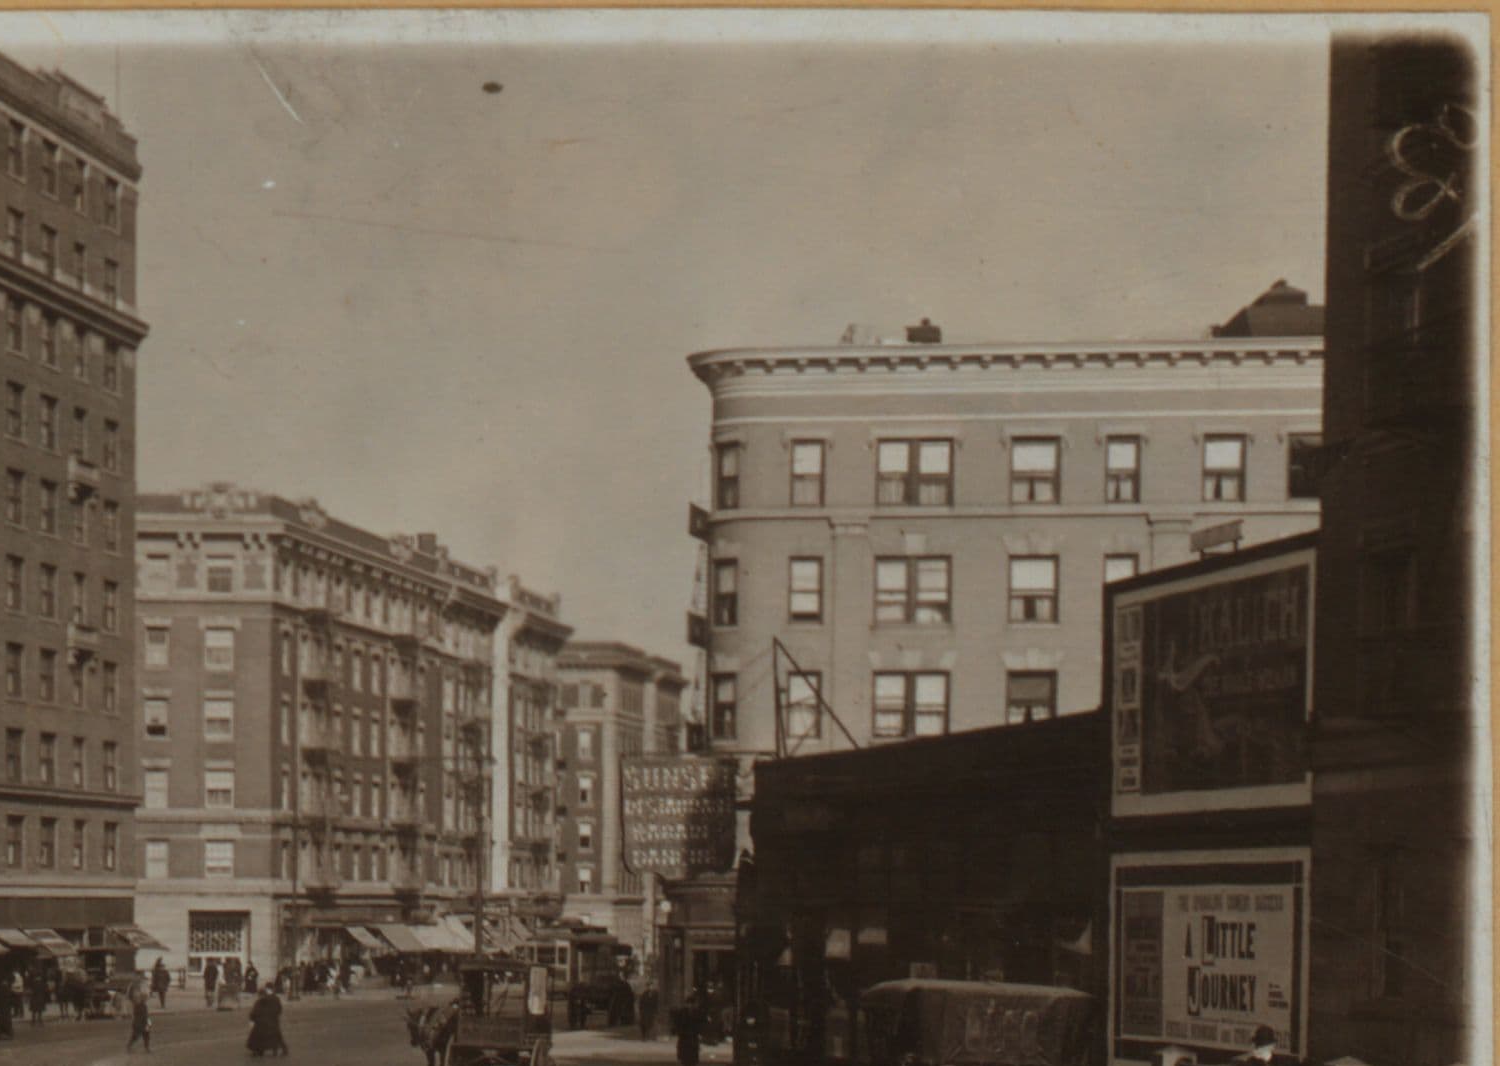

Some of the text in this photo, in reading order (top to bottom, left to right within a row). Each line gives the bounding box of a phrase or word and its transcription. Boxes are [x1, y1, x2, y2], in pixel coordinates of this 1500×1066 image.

[1185, 916, 1257, 965] A LITTLE
[1187, 966, 1257, 1016] JOURNEY
